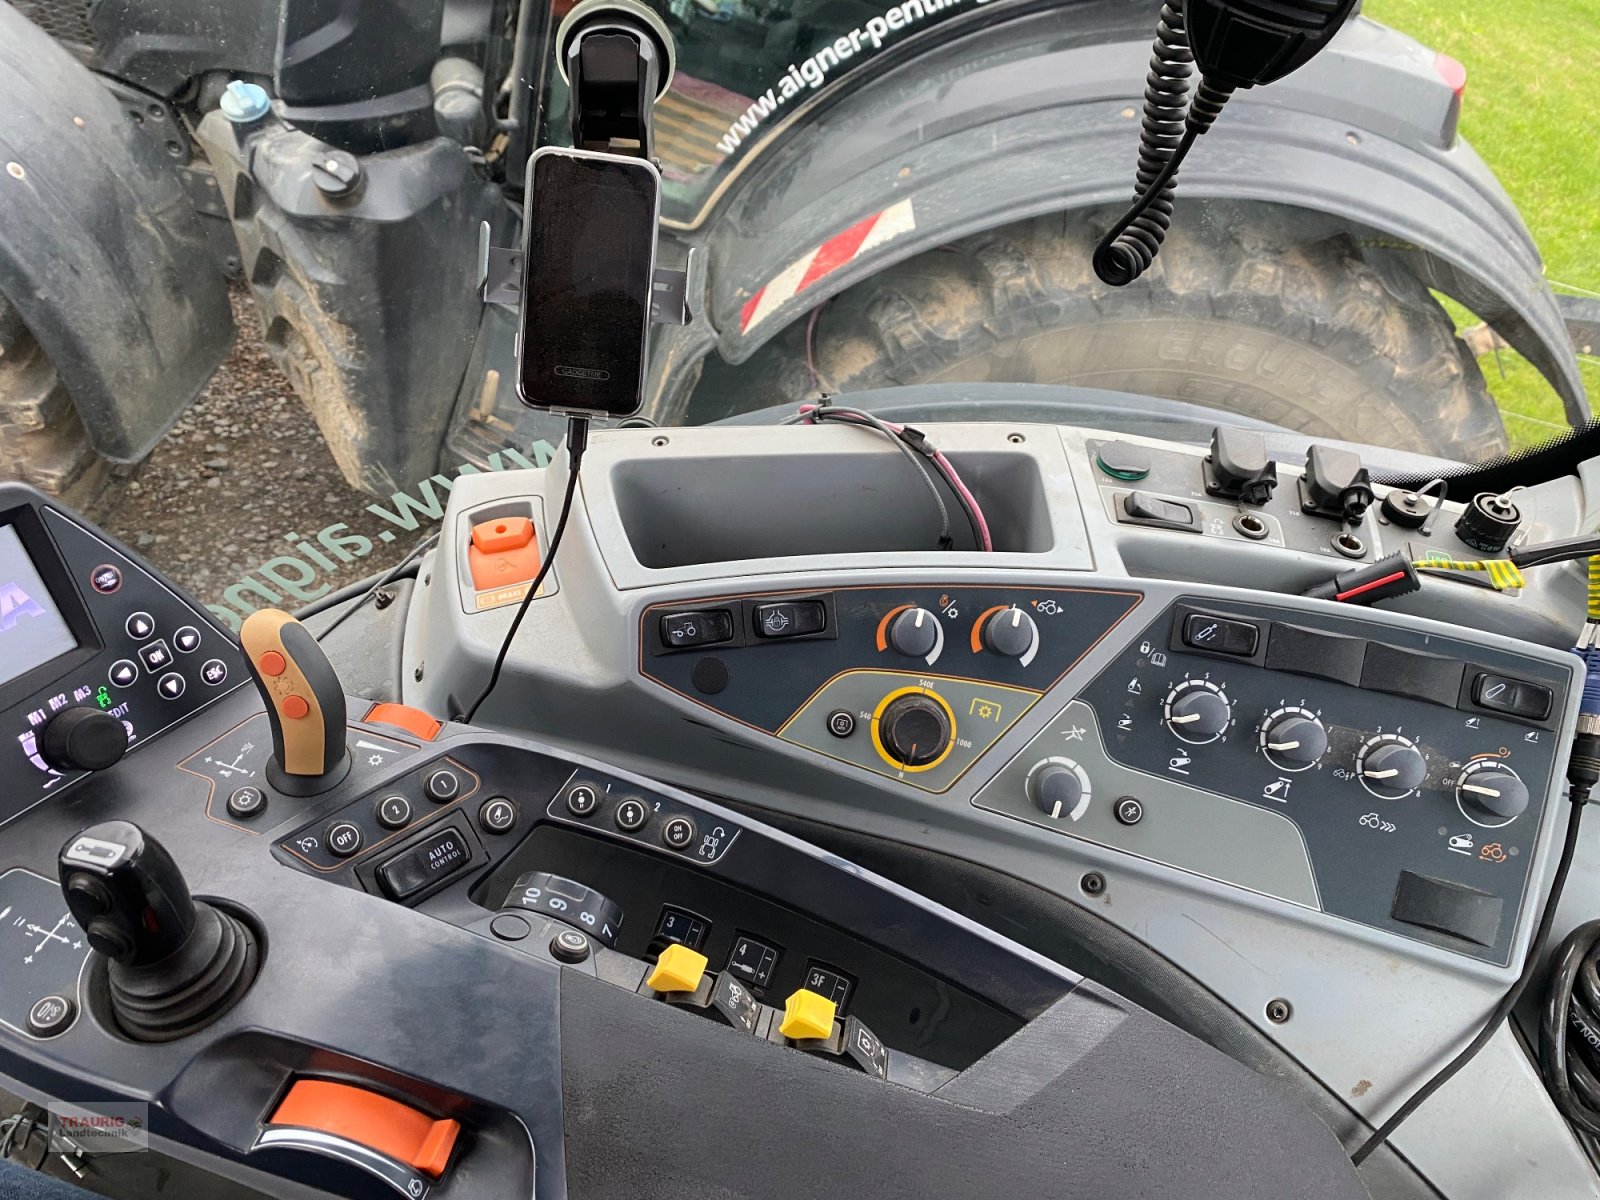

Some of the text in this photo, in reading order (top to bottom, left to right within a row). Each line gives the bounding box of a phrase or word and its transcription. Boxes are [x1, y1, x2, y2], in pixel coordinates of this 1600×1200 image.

[149, 650, 163, 662] OK
[206, 662, 223, 680] ESC
[919, 679, 934, 689] 540E
[27, 685, 92, 726] M1 M2 M3
[859, 711, 871, 720] 540
[956, 738, 972, 748] 1000
[1442, 778, 1455, 786] OFF
[606, 784, 612, 793] 1
[392, 805, 400, 814] 2
[654, 802, 661, 812] 2
[336, 832, 353, 846] OFF
[428, 841, 454, 860] AUTO
[430, 849, 461, 870] CONTROL
[522, 887, 612, 938] 10 9 8 7
[666, 916, 675, 927] 3
[739, 944, 748, 956] 4
[811, 973, 825, 987] 3F
